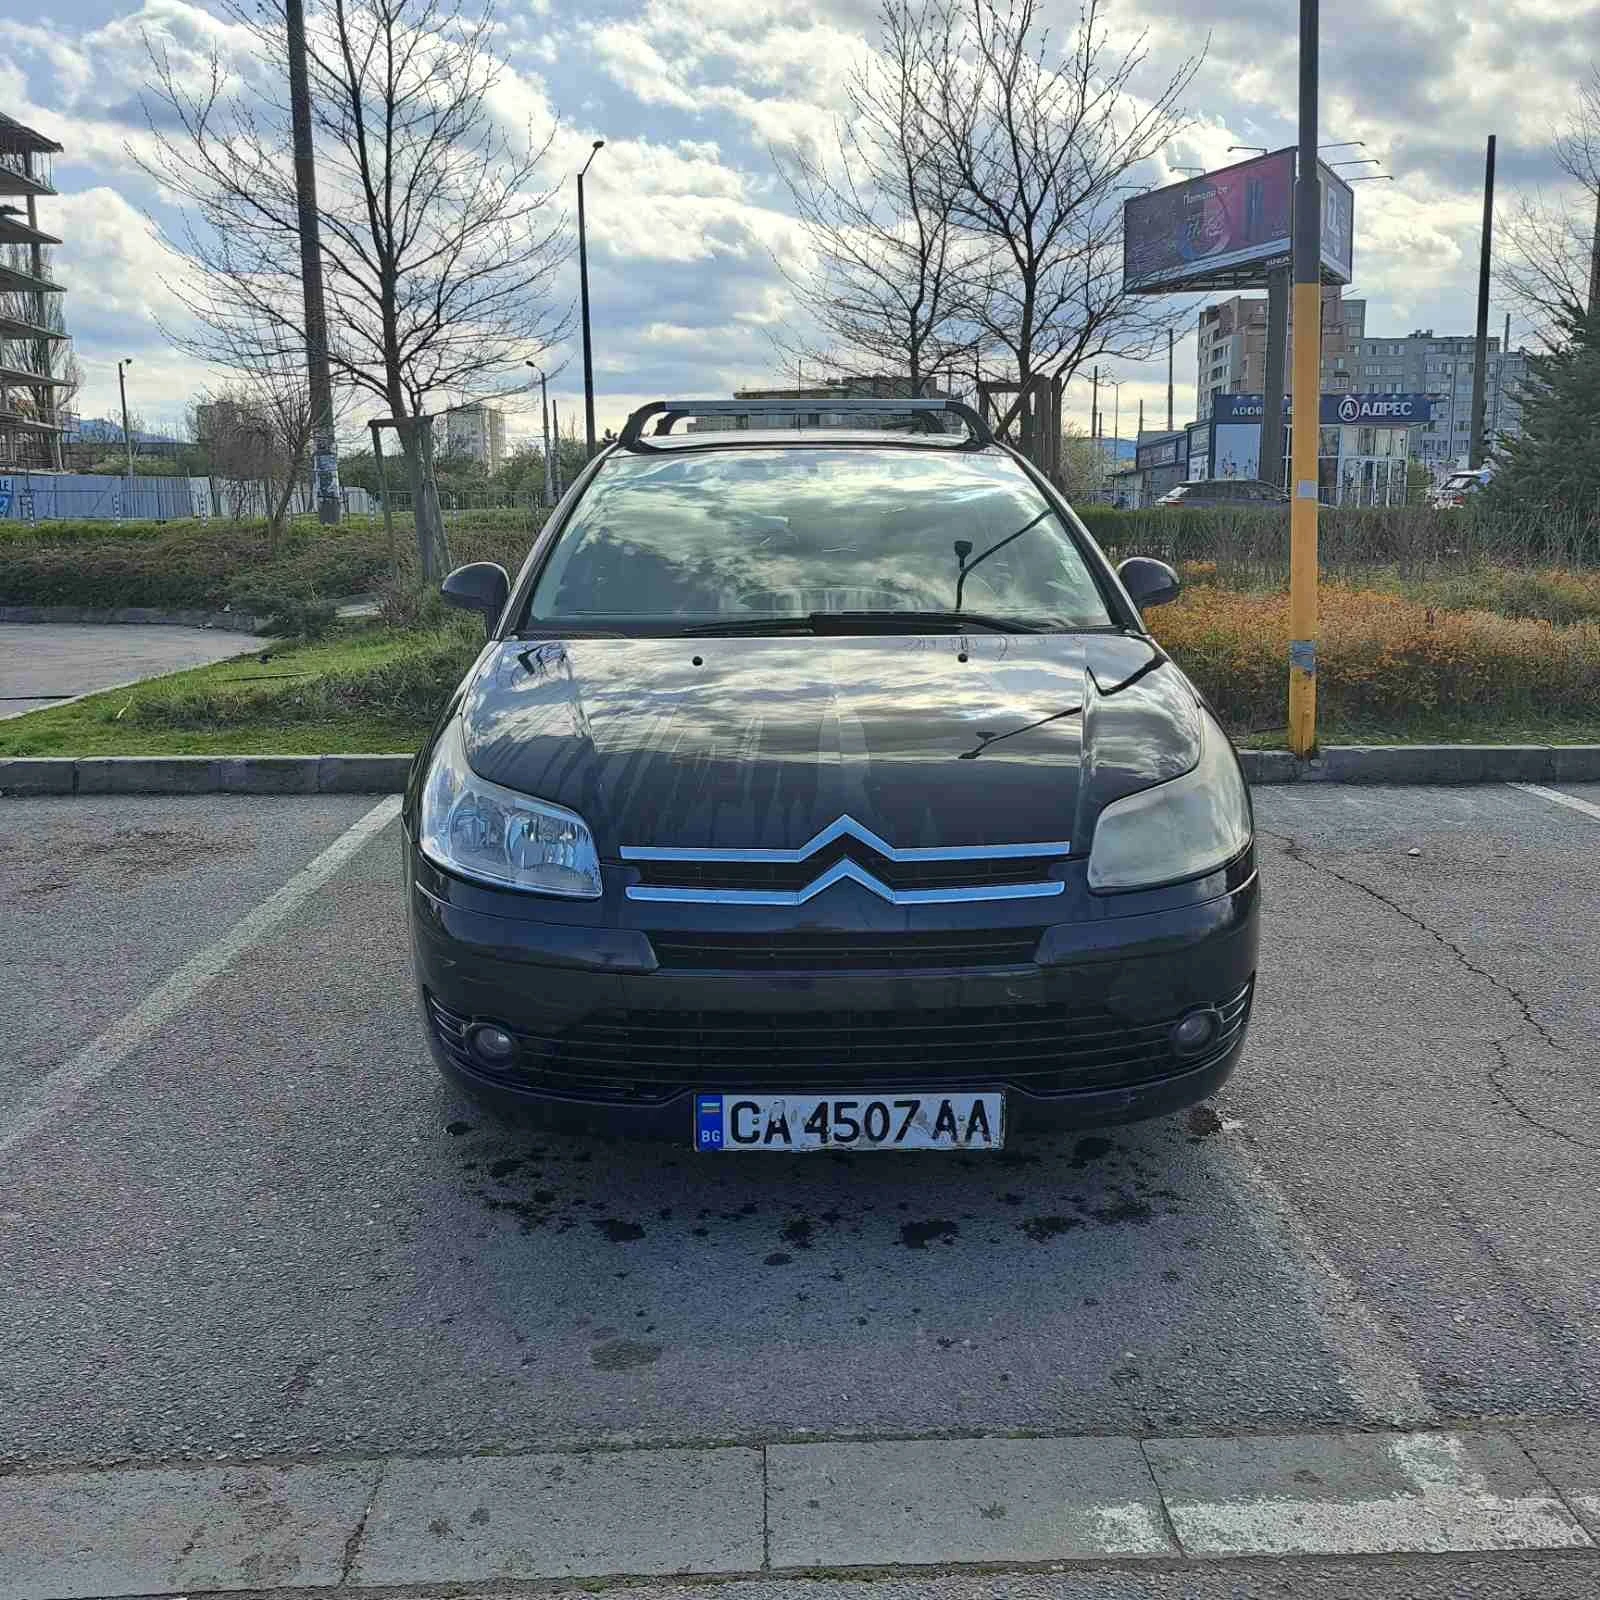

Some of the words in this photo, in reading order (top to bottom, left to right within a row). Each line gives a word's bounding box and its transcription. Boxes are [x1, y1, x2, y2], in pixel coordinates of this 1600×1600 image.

[1360, 402, 1413, 417] АДРЕС
[730, 1100, 793, 1144] CA
[803, 1100, 920, 1144] 4507
[931, 1099, 992, 1142] AA
[701, 1130, 721, 1142] BG
